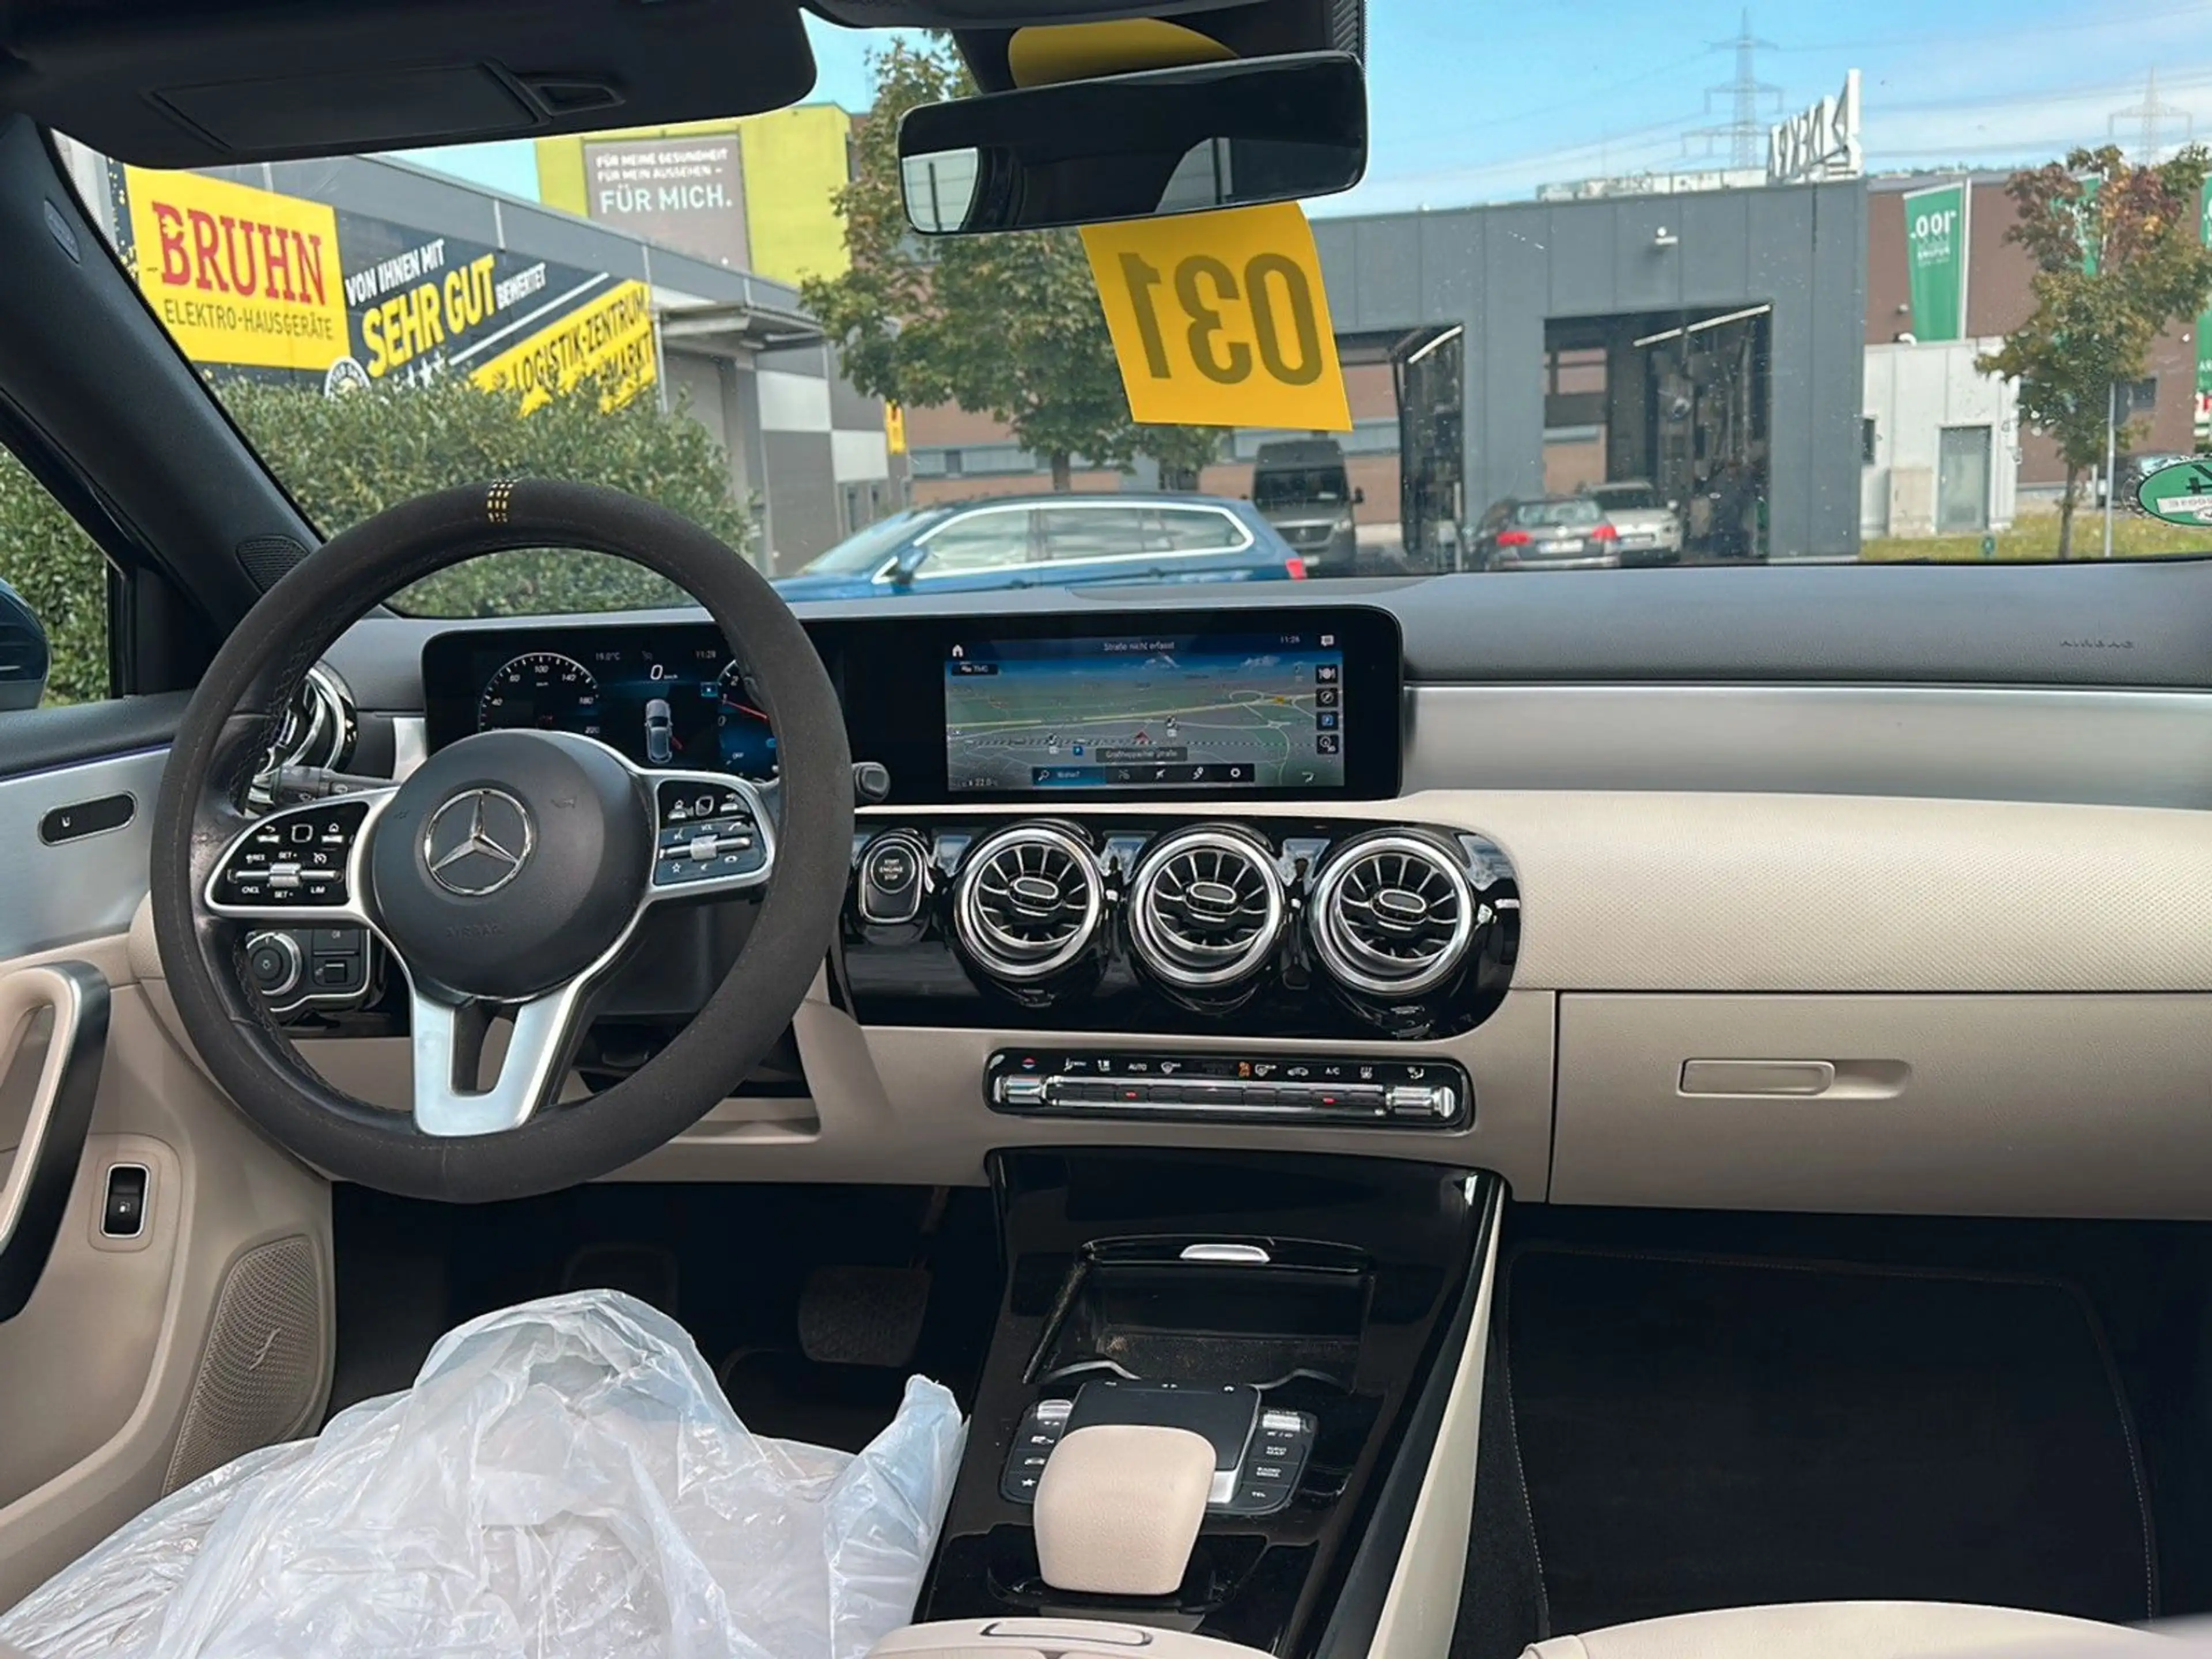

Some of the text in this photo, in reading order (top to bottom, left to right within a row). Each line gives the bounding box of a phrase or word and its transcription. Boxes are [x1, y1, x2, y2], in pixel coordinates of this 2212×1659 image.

[600, 183, 733, 214] FÜR MICH.
[152, 200, 325, 306] BRUHN
[346, 238, 444, 306] VON IHNEN MIT
[362, 282, 445, 378] SEHR
[444, 253, 494, 334] GUT
[650, 665, 662, 680] 0
[1128, 1063, 1147, 1071] AUTO
